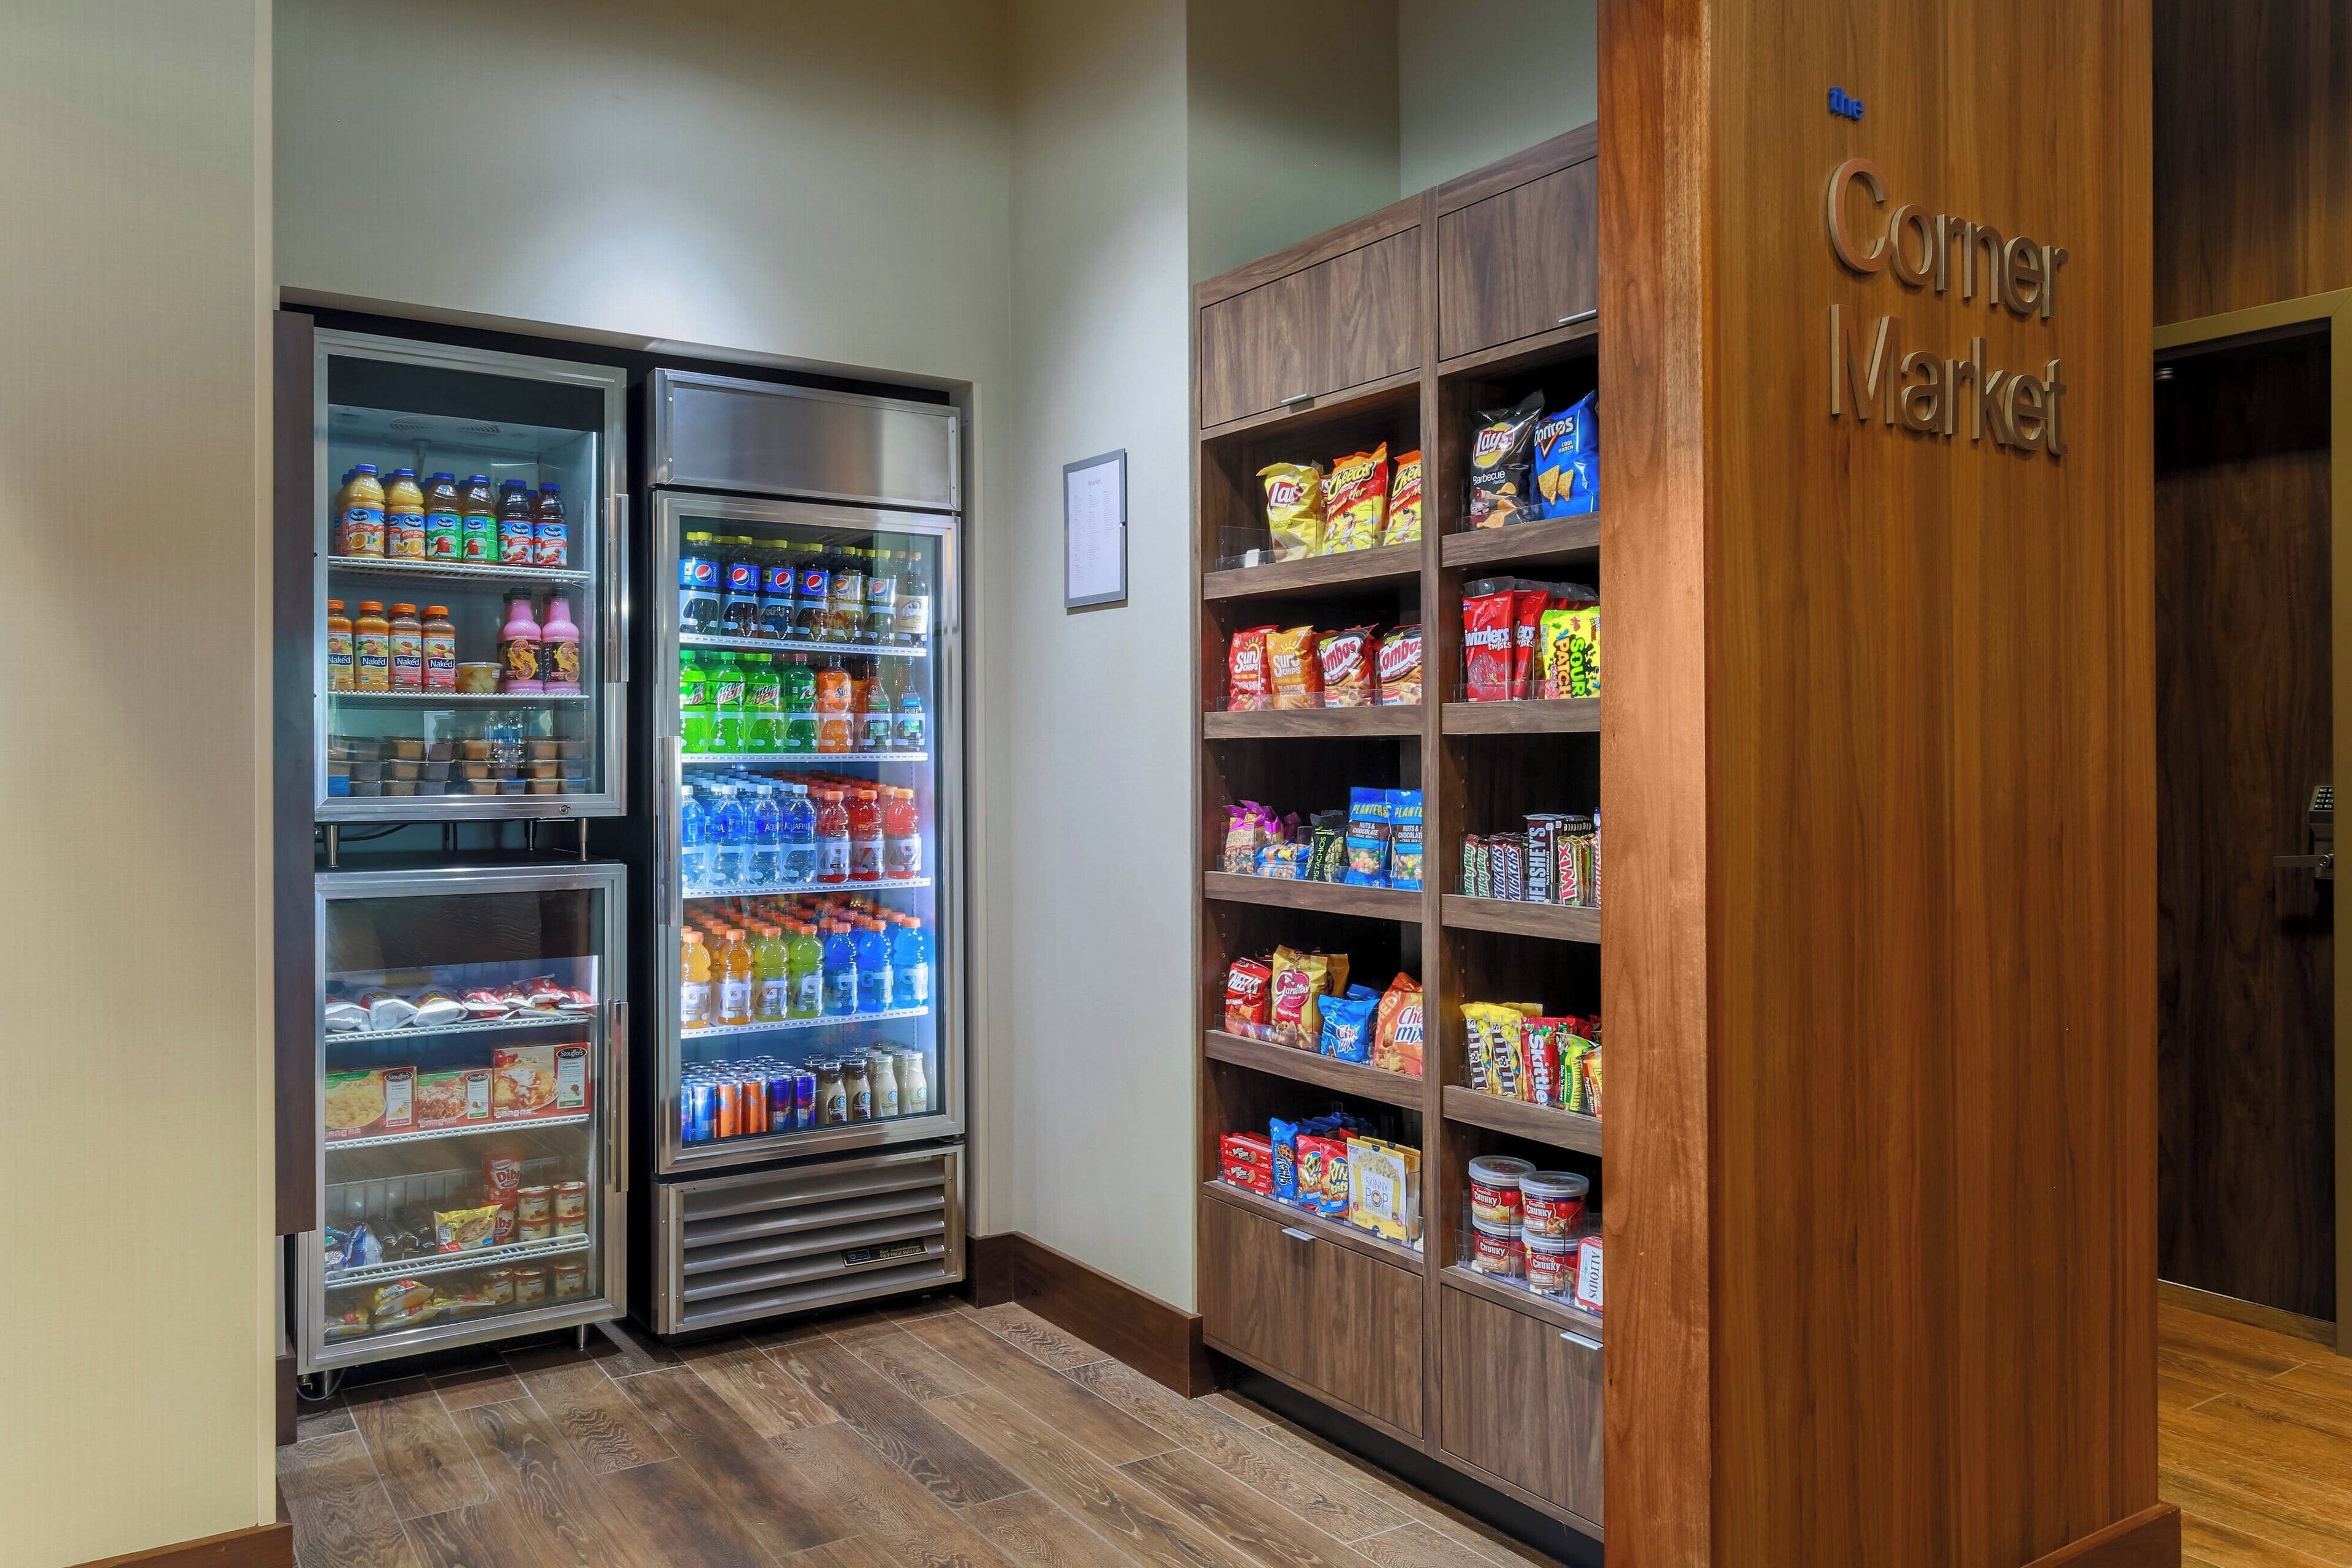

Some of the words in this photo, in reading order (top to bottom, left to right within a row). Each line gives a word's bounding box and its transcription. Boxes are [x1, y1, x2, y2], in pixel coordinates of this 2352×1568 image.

[1829, 85, 1864, 121] the
[1828, 158, 2069, 318] Corner
[1830, 303, 2069, 456] Market
[1473, 470, 1506, 485] Barbecue
[1465, 625, 1510, 647] wizzlers
[1488, 640, 1512, 651] twists
[328, 655, 351, 664] Naked
[363, 657, 386, 665] Naked
[1234, 650, 1260, 673] Sun
[1556, 636, 1572, 698] PATCH
[1570, 637, 1585, 696] SOUR
[1351, 804, 1388, 818] PLANTERS
[1313, 837, 1326, 882] PISTACHIOS
[1529, 827, 1546, 903] HERSHEY'S
[1558, 842, 1576, 905] TWIX
[560, 1049, 584, 1057] Stouffer's
[1572, 1060, 1581, 1085] NATURE
[1366, 1176, 1389, 1192] SKINNY
[1365, 1187, 1389, 1210] POP
[1474, 1190, 1498, 1206] CHUNKY
[1526, 1204, 1552, 1218] CHUNKY
[880, 1248, 922, 1259] REFRIGERATOR
[1480, 1242, 1506, 1257] CHUNKY
[1532, 1259, 1561, 1272] CHUNKY
[1589, 1251, 1601, 1299] ALTOIDS
